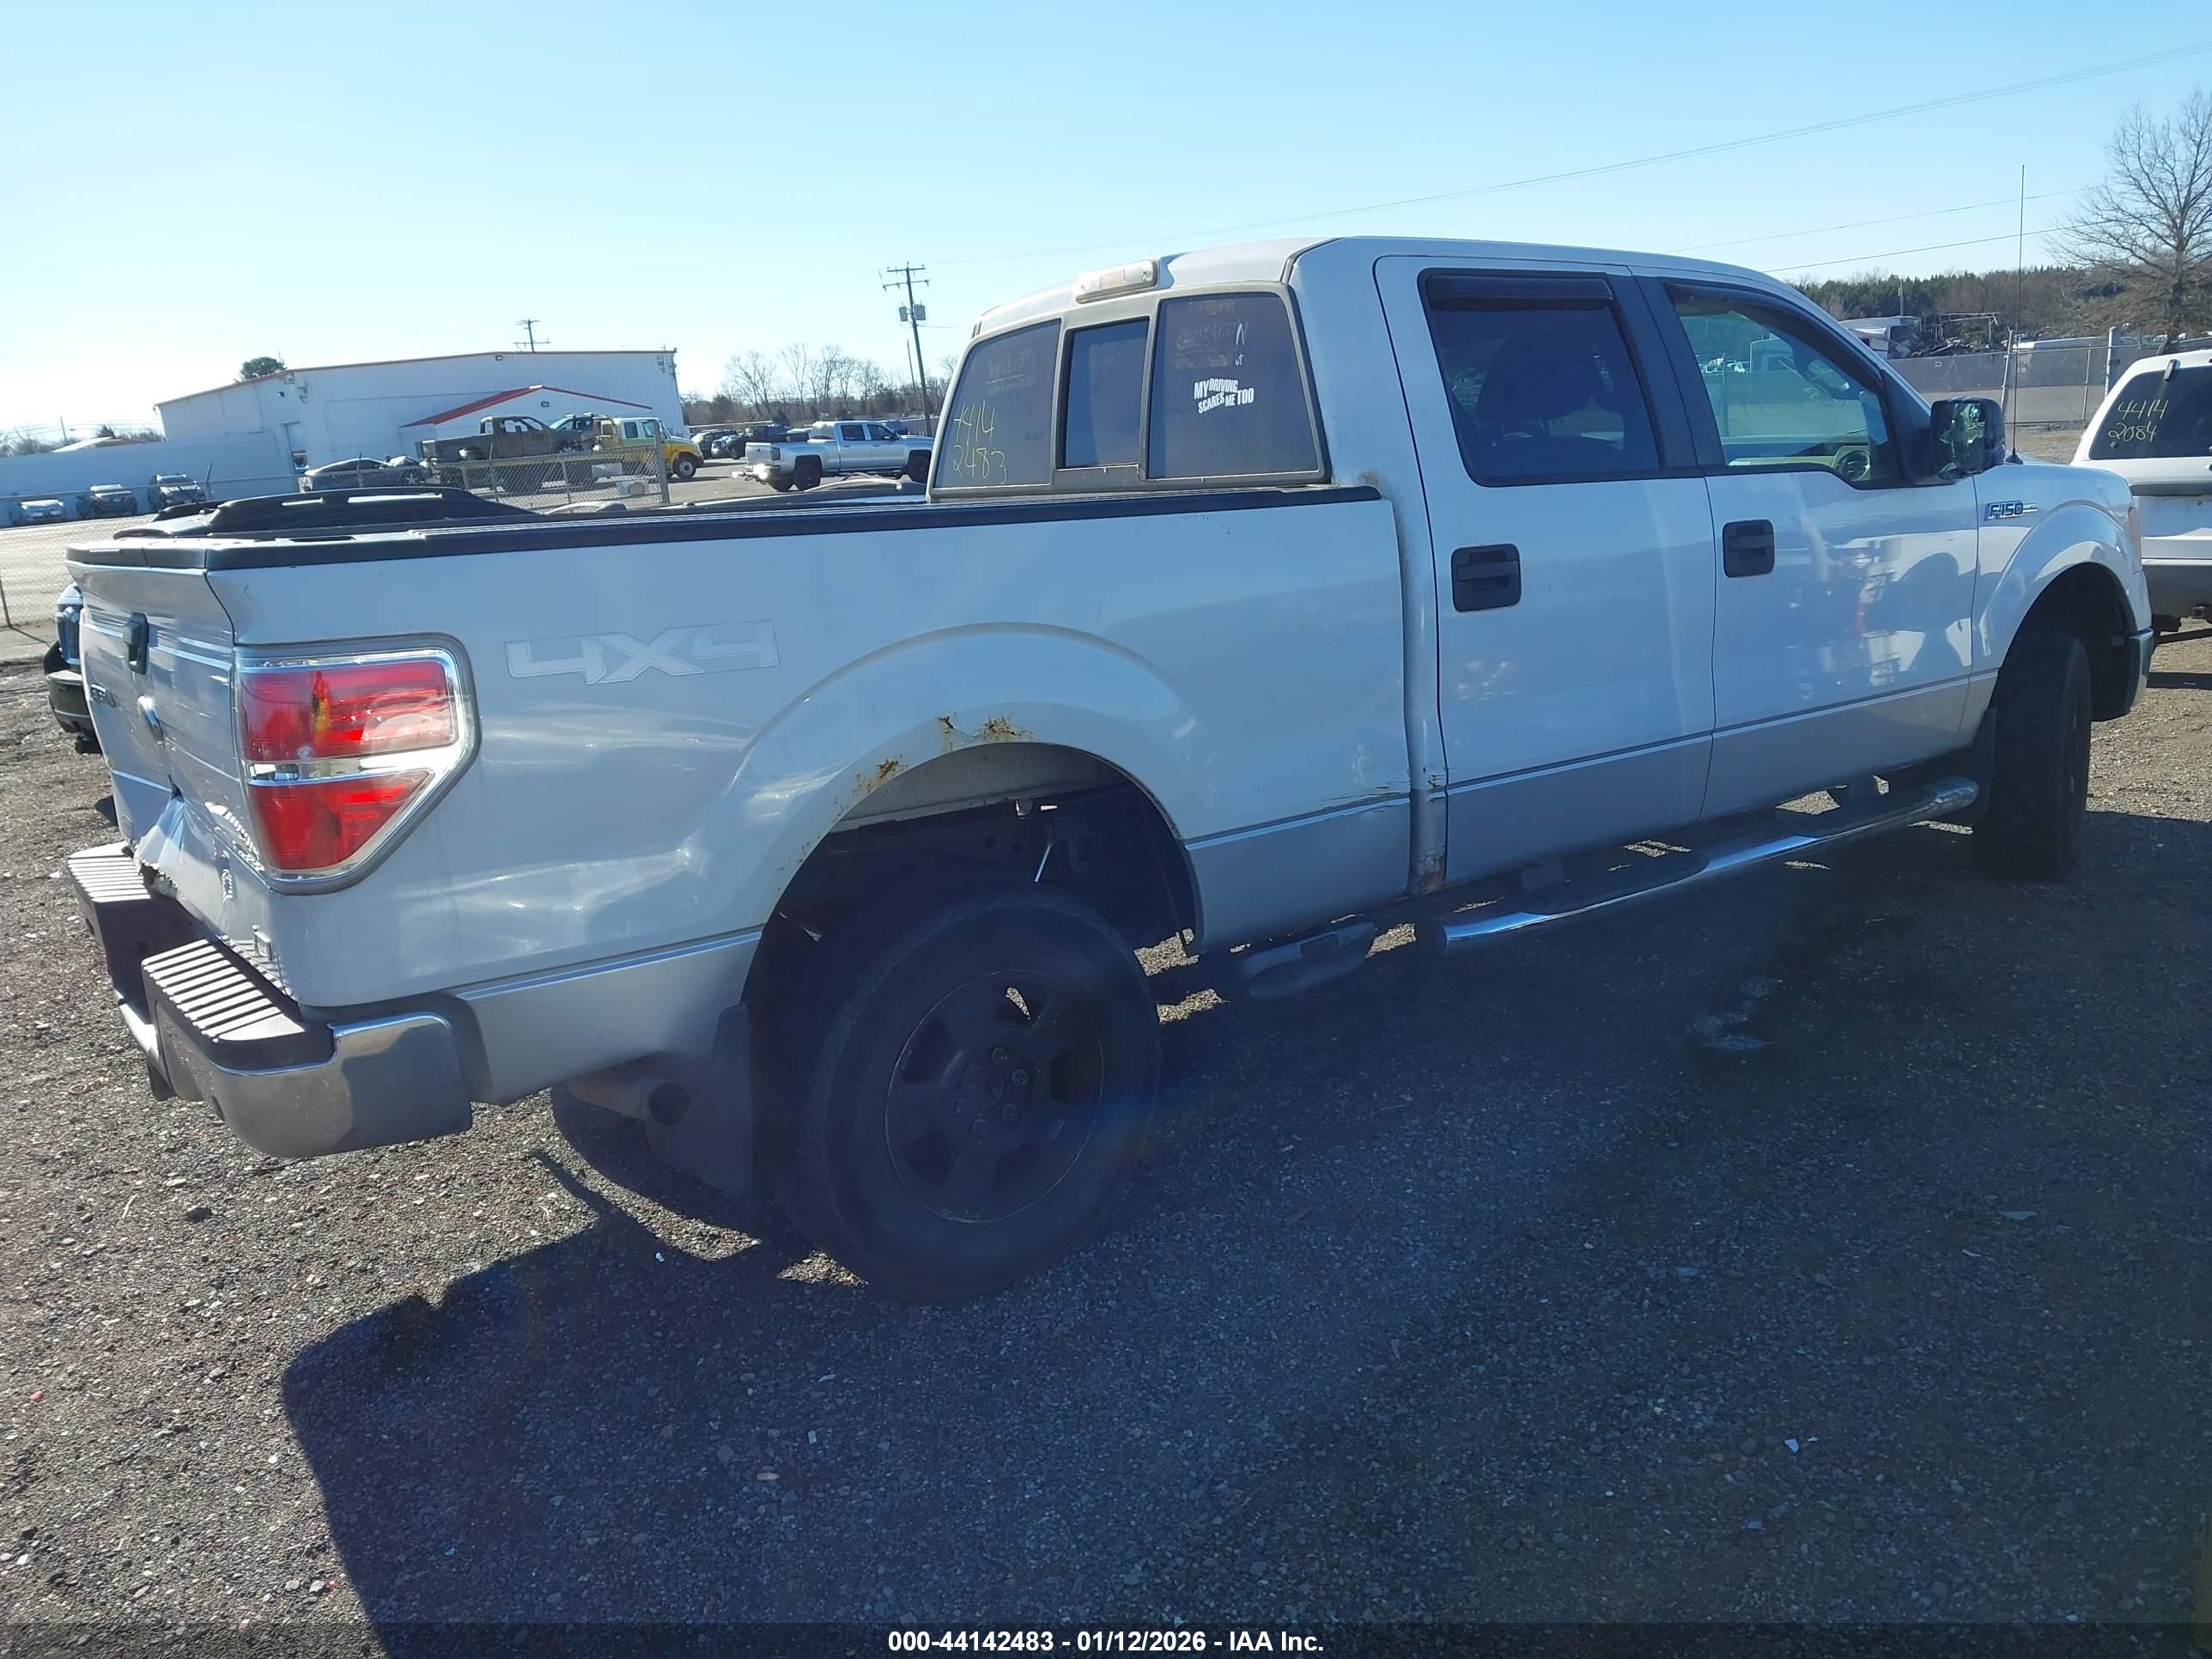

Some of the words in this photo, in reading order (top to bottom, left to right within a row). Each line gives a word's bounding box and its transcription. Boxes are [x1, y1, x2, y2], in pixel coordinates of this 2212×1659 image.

[1194, 380, 1210, 399] MY
[1209, 378, 1238, 392] DRIVING
[1198, 392, 1224, 414] SCARES
[1225, 393, 1237, 407] ME
[1237, 387, 1255, 405] TOO
[2117, 398, 2169, 420] 4414
[953, 441, 1007, 484] 2483
